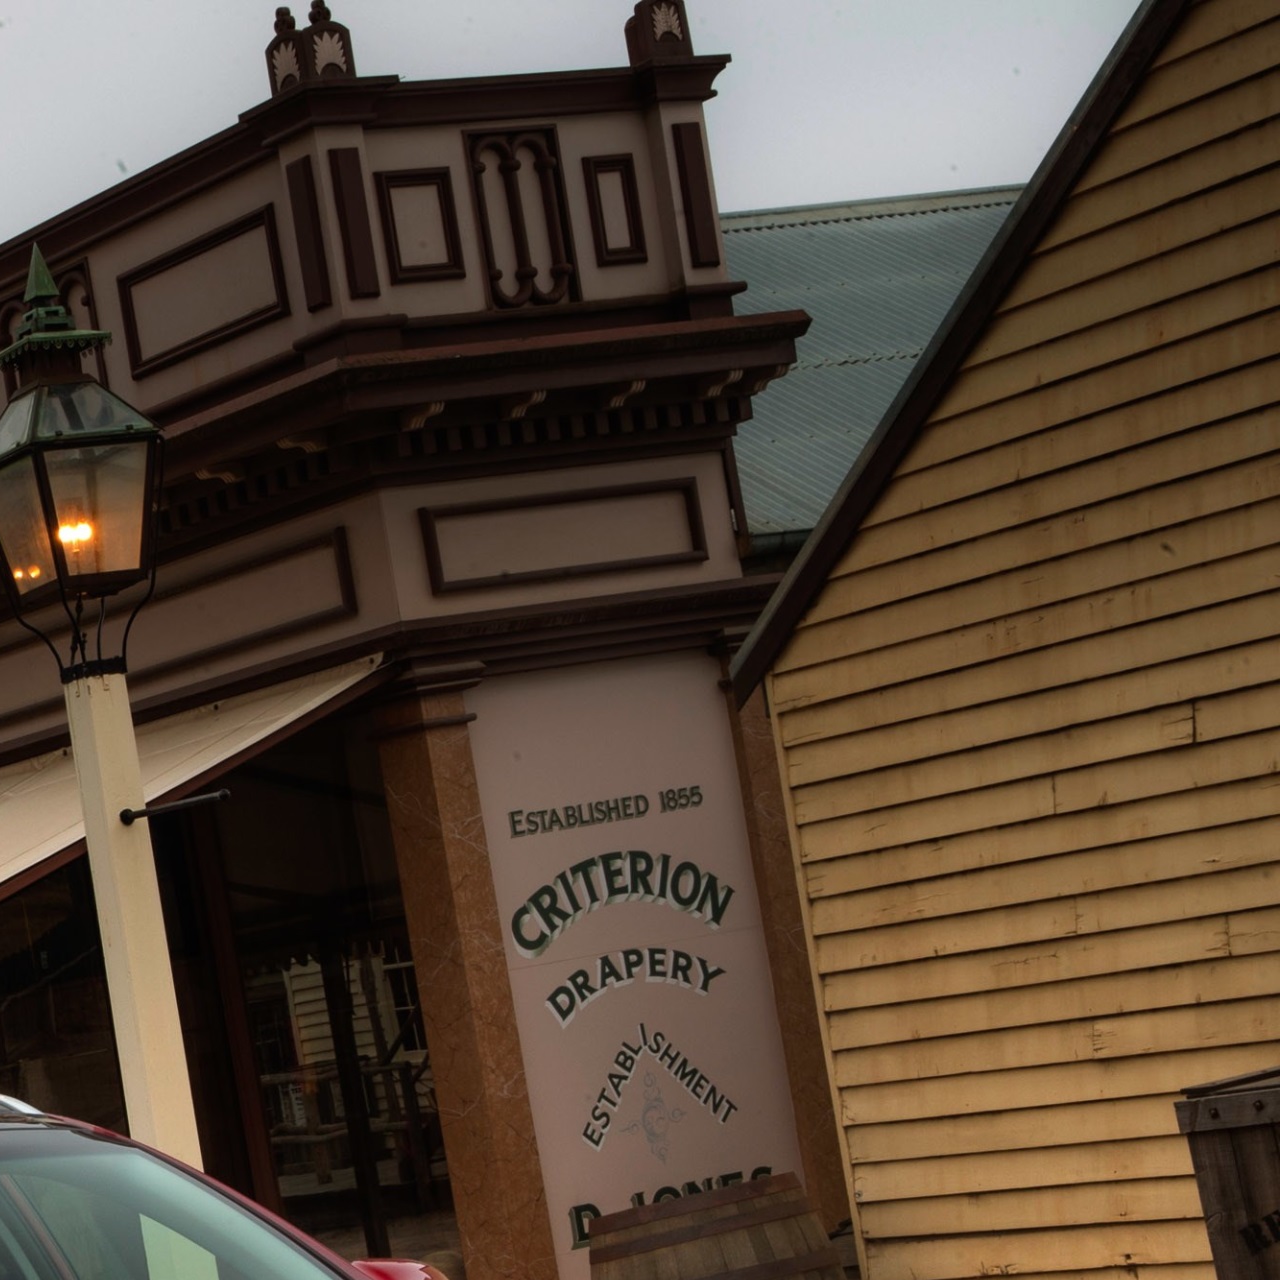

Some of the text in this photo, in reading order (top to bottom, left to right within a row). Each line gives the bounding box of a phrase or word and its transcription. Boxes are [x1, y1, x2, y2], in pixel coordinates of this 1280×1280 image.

[509, 785, 703, 838] ESTABLISHED 1855
[510, 850, 736, 957] CRITERION
[546, 947, 727, 1028] DRAPERY
[582, 1022, 738, 1151] ESTABLISHMENT
